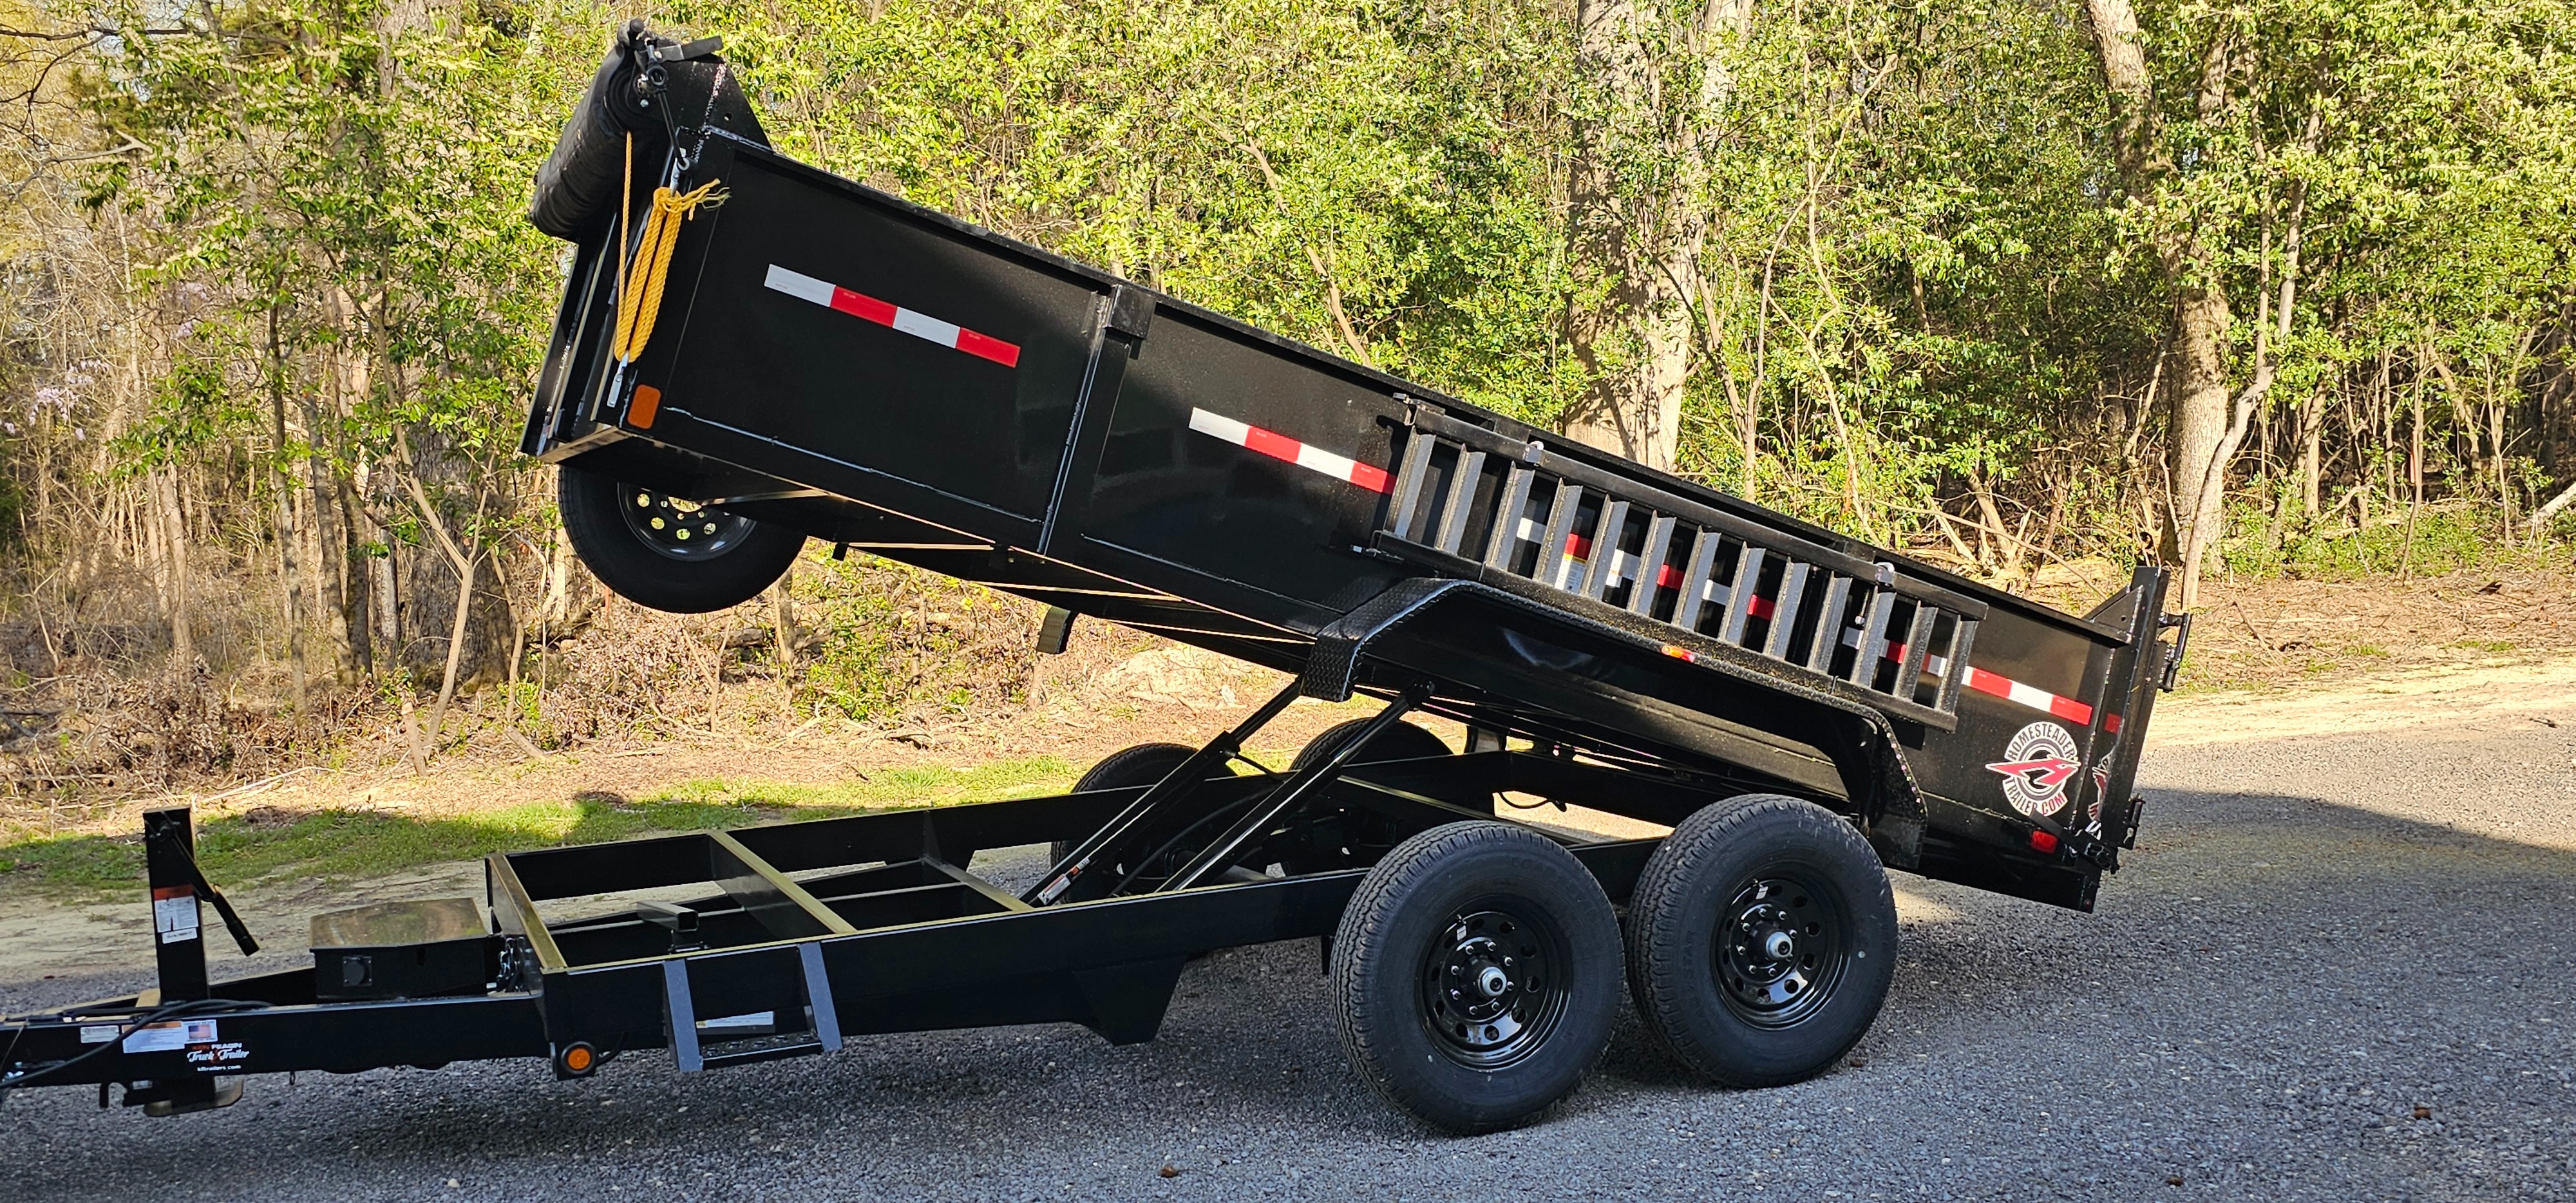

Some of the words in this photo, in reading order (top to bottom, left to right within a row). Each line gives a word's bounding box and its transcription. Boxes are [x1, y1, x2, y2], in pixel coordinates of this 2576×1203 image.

[2007, 723, 2075, 761] HOMESTEADER
[187, 1050, 214, 1062] Truck
[217, 1048, 250, 1061] Trailer
